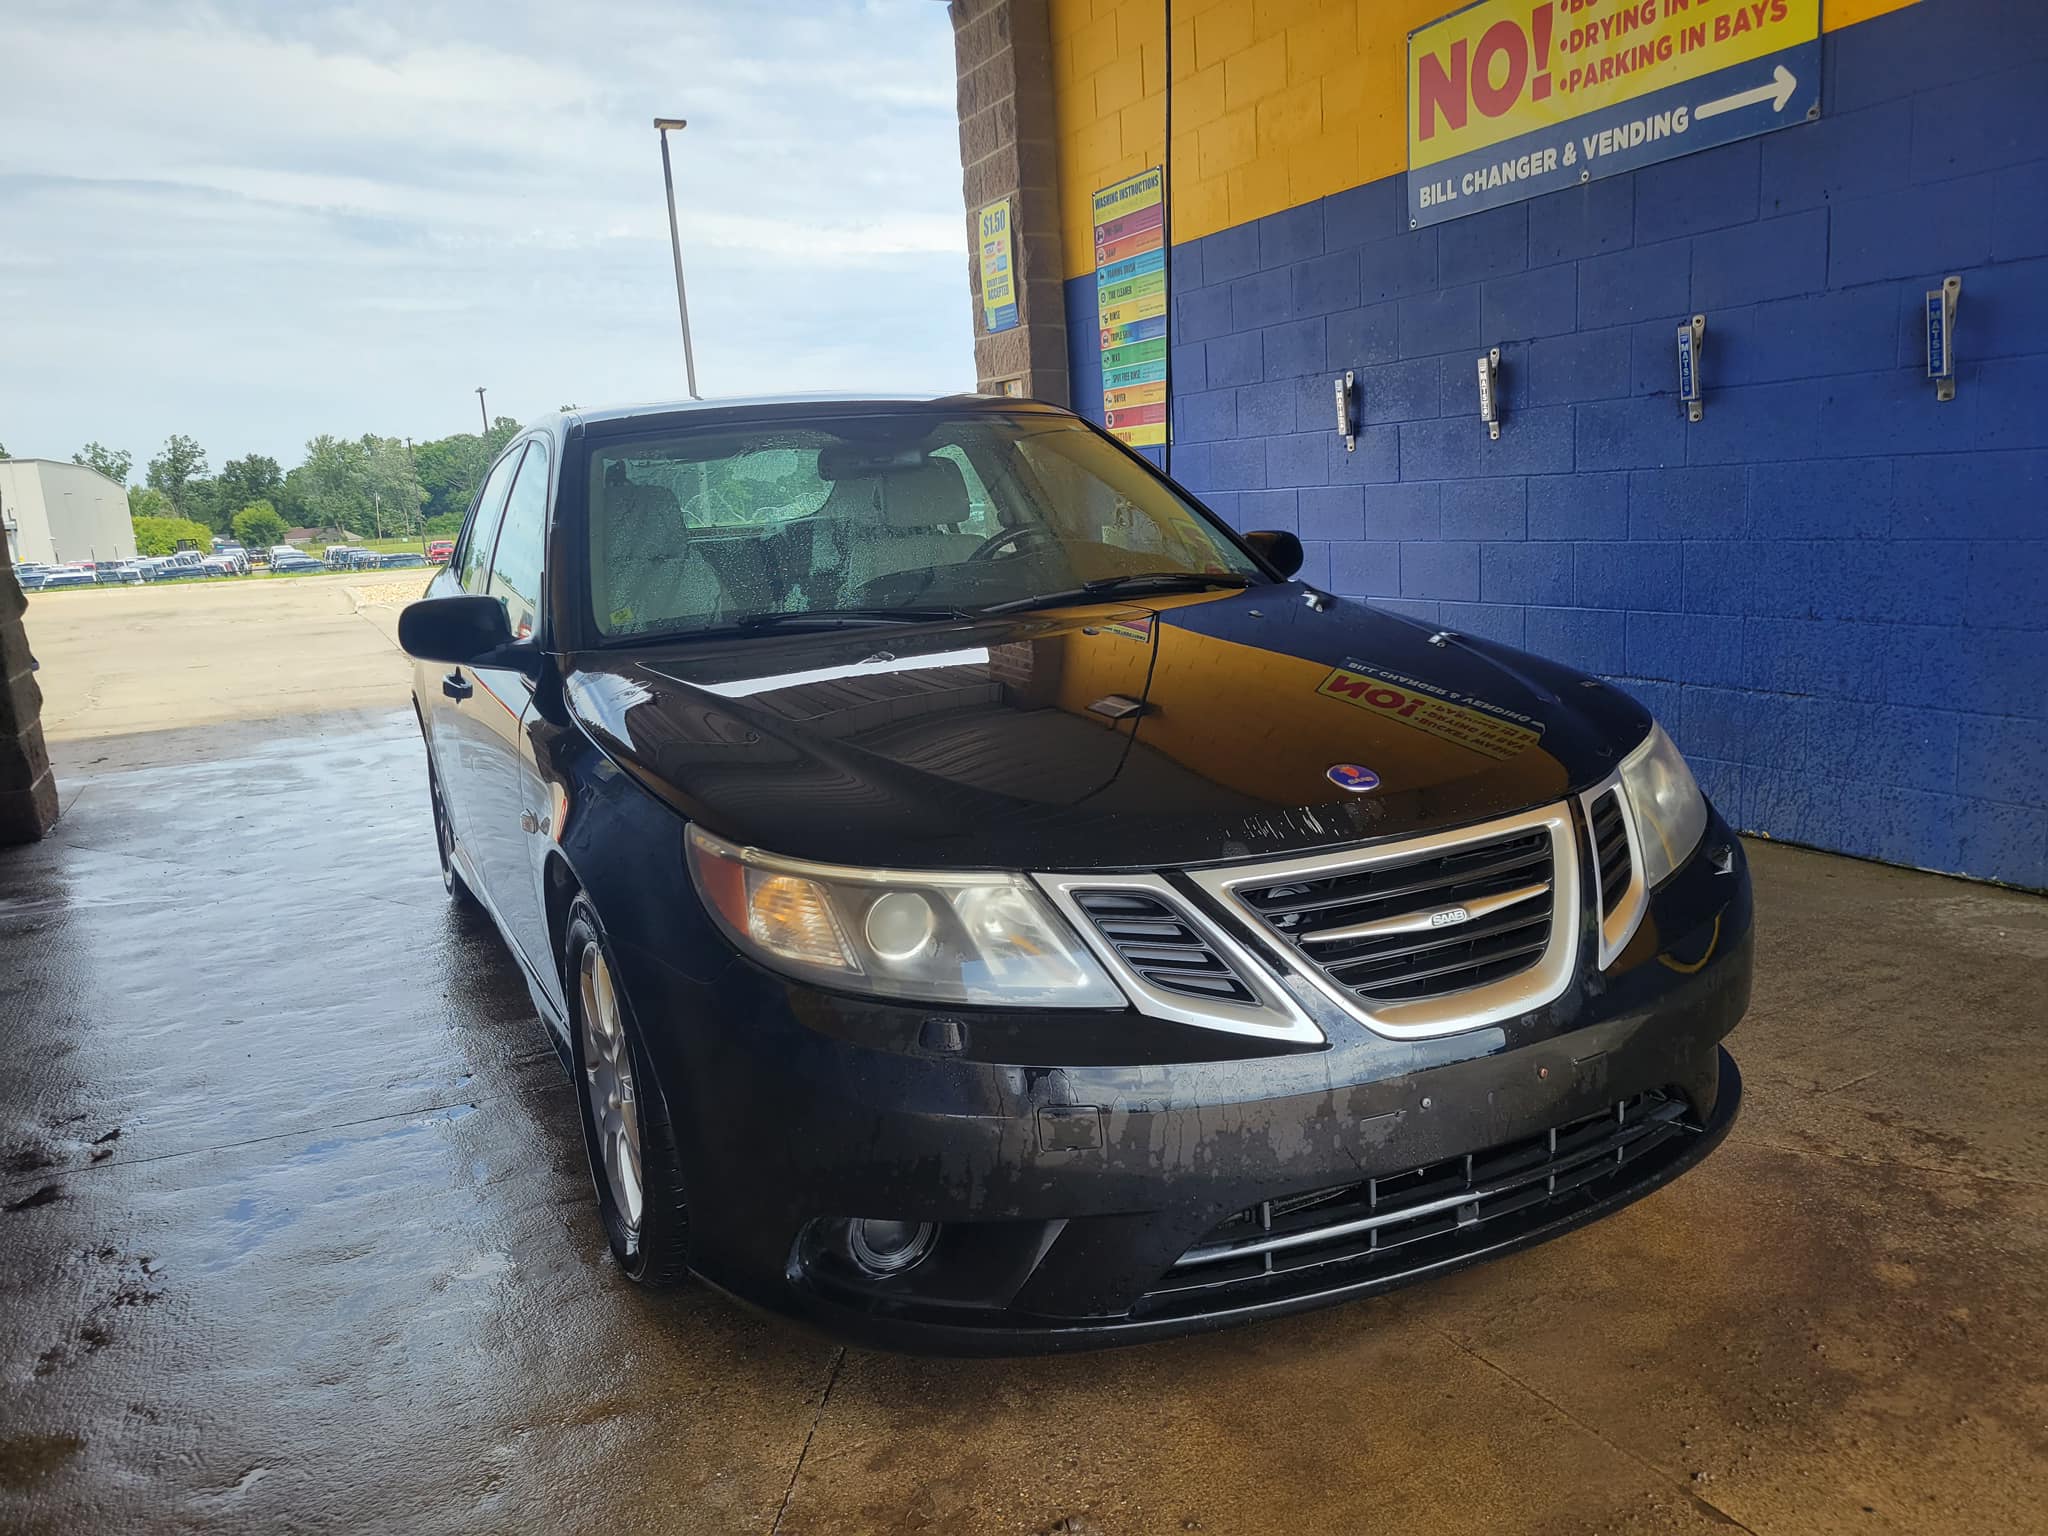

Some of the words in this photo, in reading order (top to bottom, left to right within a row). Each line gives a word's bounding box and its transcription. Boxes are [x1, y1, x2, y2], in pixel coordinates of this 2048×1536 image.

[1419, 3, 1554, 142] NO!
[1569, 35, 1673, 93] PARKING
[1680, 22, 1706, 55] IN
[1714, 0, 1788, 43] BAYS
[1419, 179, 1457, 209] BILL
[1461, 147, 1558, 196] CHANGER
[1562, 142, 1577, 167] &
[1582, 106, 1690, 160] VENDING
[984, 208, 1006, 238] $1.50
[1432, 910, 1465, 926] SAAB
